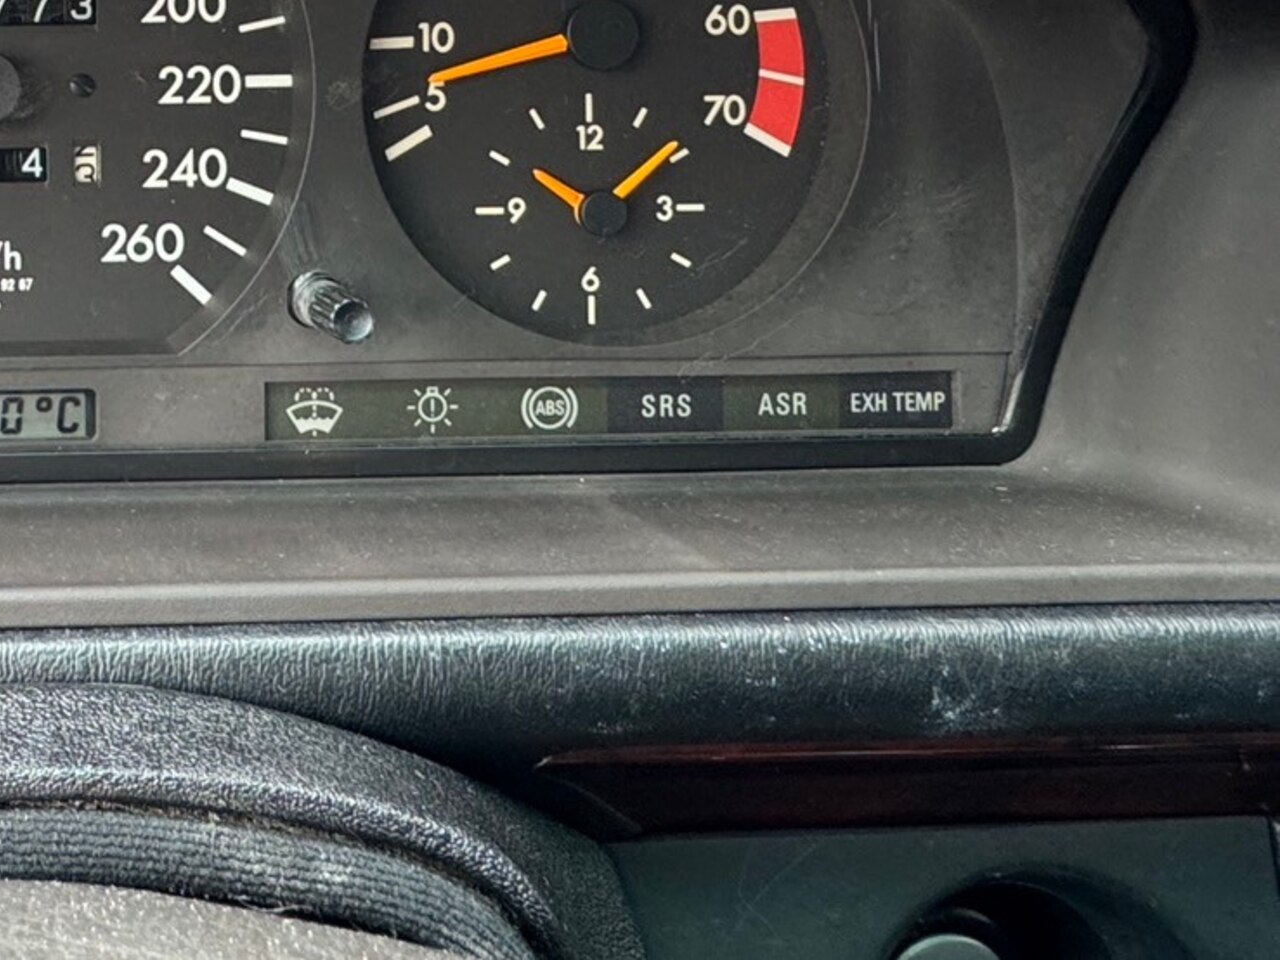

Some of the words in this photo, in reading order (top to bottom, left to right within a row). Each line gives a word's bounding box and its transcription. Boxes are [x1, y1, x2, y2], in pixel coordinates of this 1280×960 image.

[705, 4, 750, 35] 60
[418, 22, 454, 53] 10
[158, 64, 241, 105] 220
[424, 81, 447, 113] 5
[702, 93, 747, 127] 70
[576, 124, 604, 150] 12
[141, 147, 228, 190] 240
[507, 197, 526, 224] 9
[656, 195, 673, 222] 3
[100, 223, 184, 264] 260
[581, 266, 600, 292] 6
[536, 400, 564, 415] ABS
[641, 393, 692, 418] SRS
[758, 392, 807, 416] ASR
[850, 392, 888, 413] EXH
[892, 391, 946, 412] TEMP
